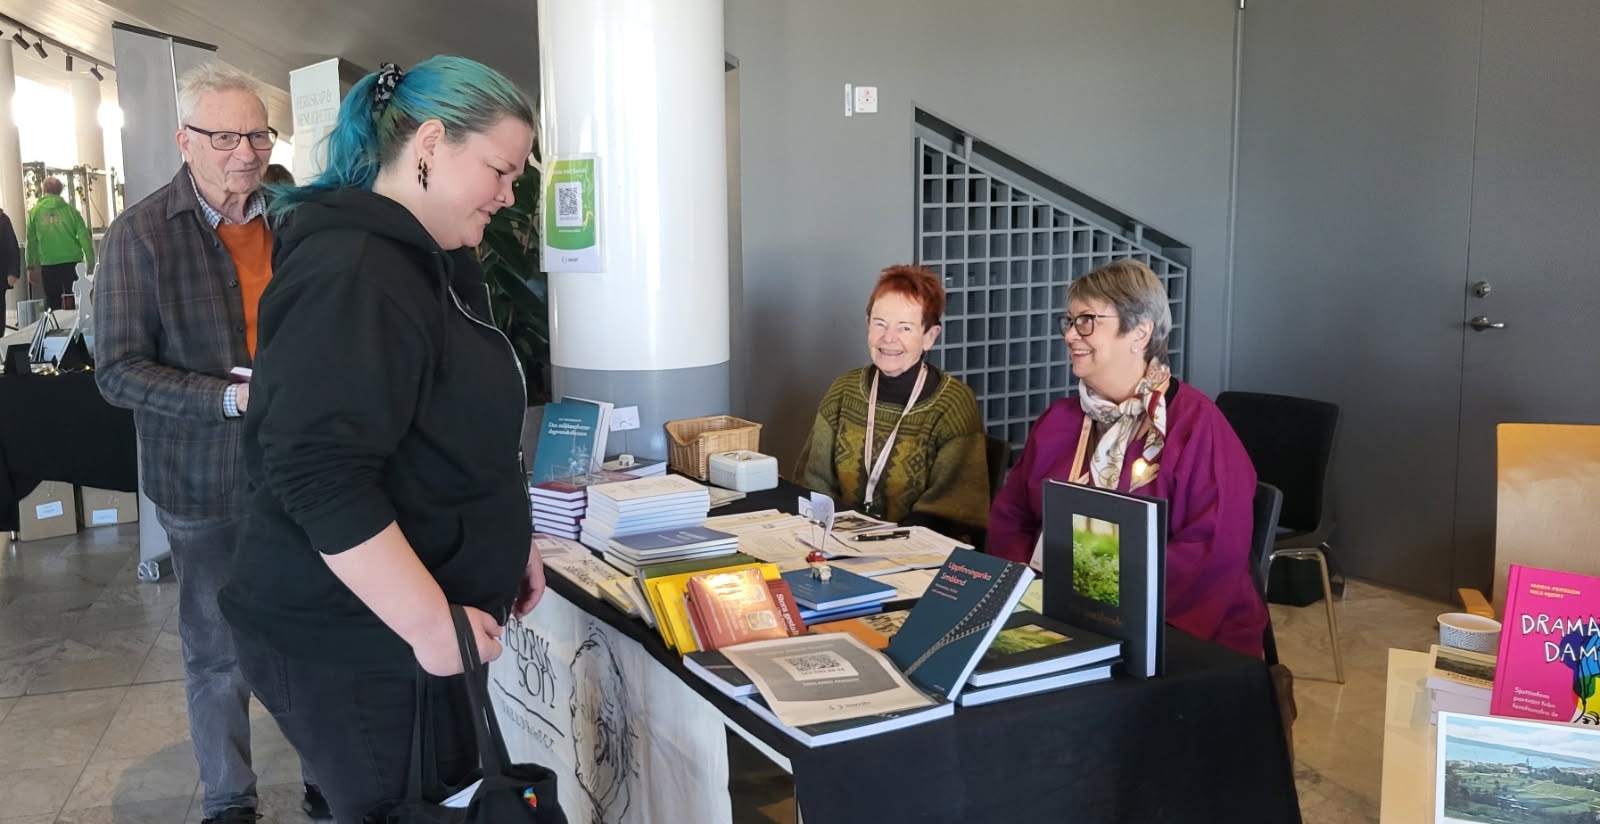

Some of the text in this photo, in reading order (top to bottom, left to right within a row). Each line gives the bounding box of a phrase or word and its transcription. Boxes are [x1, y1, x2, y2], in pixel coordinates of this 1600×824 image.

[941, 573, 967, 586] Småland
[949, 562, 992, 581] Uppfinningsrika
[1520, 613, 1600, 638] DRAMA
[1544, 640, 1600, 663] DAM
